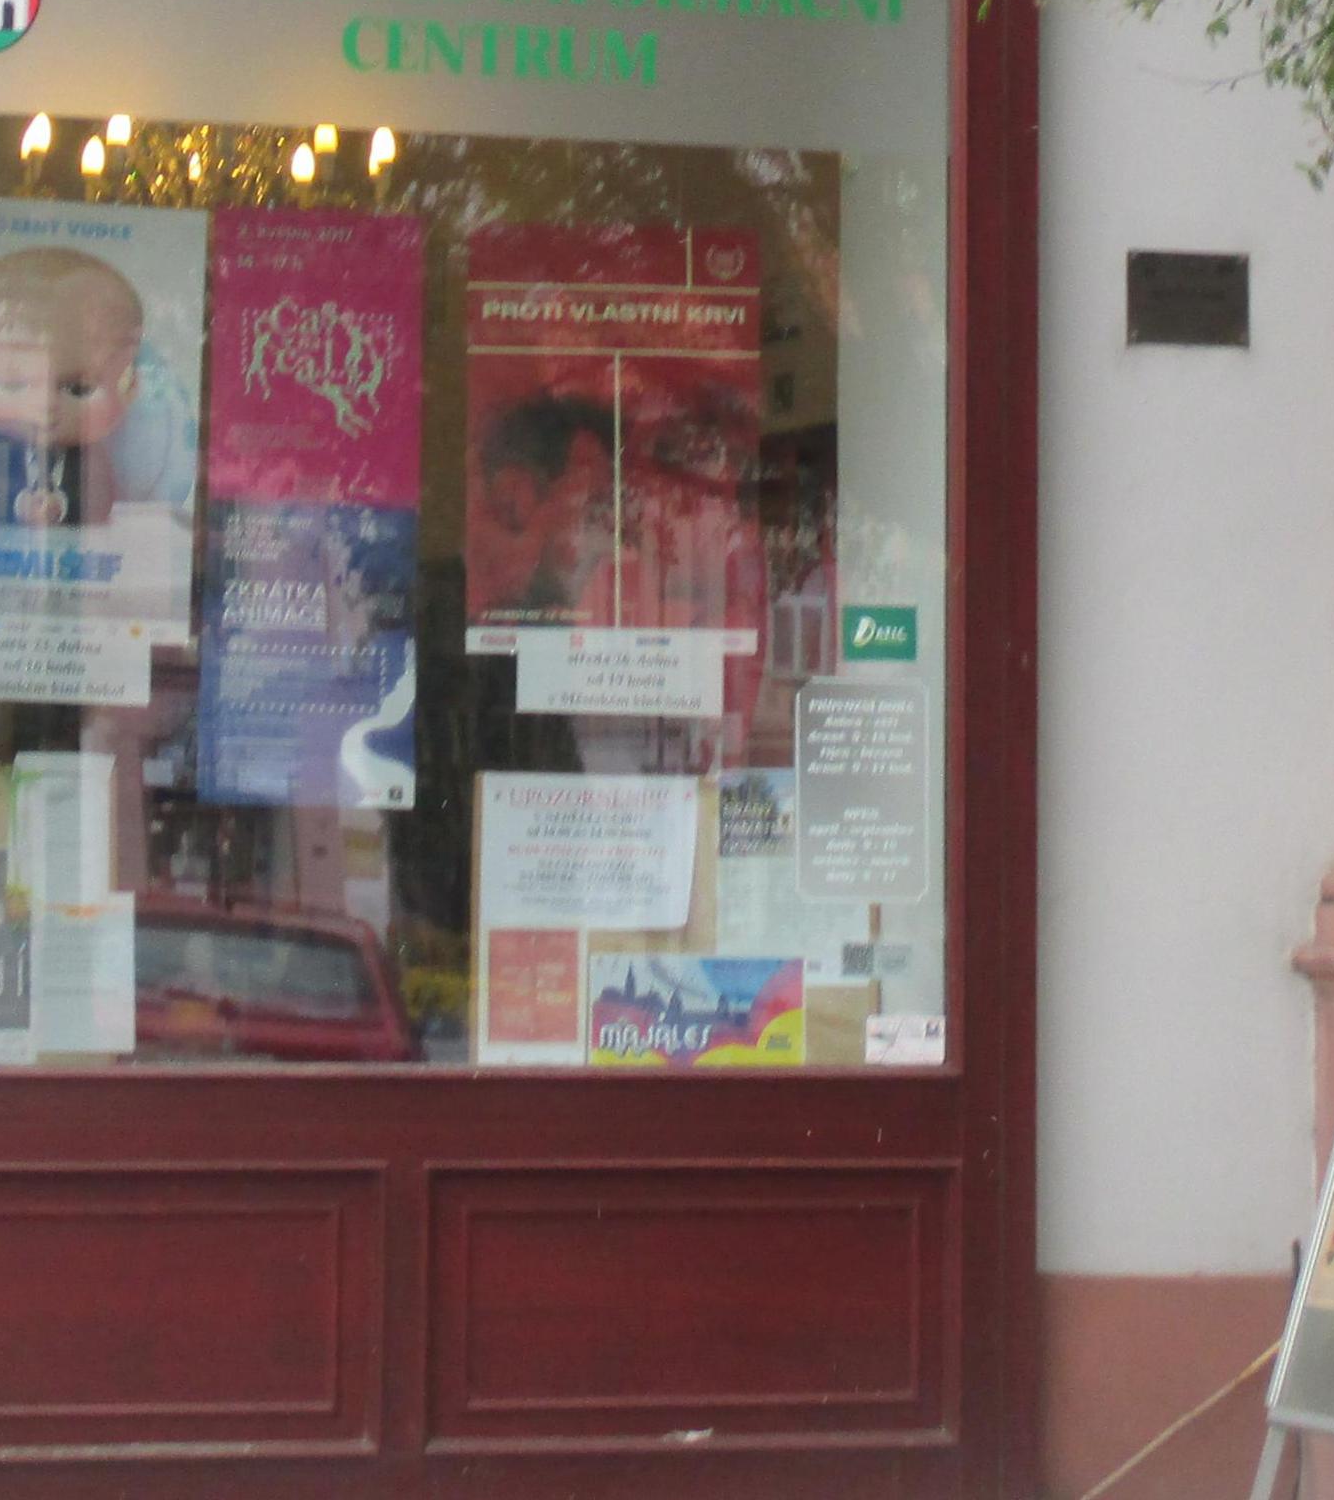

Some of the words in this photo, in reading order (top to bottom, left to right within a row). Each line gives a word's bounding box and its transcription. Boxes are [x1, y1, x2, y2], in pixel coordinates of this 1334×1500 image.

[341, 14, 659, 88] CENTRUM
[482, 299, 563, 321] PROTI
[569, 300, 680, 325] VLASTNÍ
[686, 304, 747, 326] KRVI
